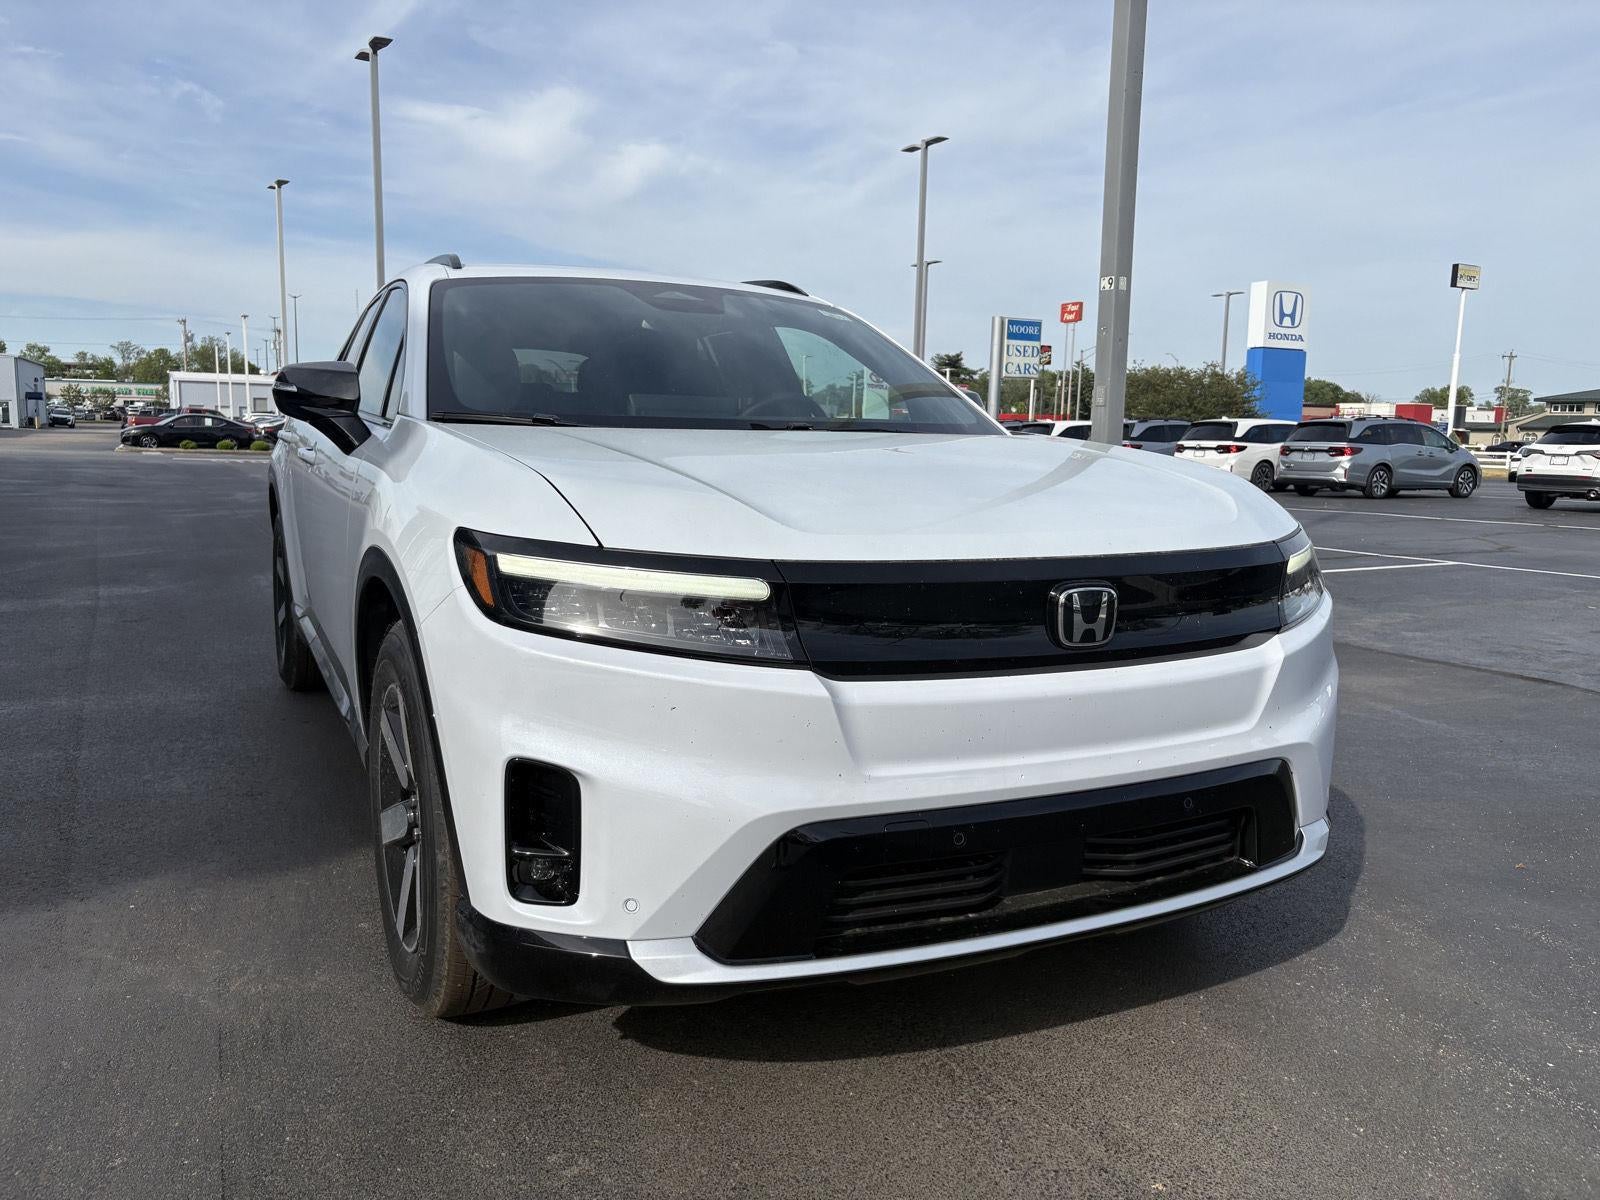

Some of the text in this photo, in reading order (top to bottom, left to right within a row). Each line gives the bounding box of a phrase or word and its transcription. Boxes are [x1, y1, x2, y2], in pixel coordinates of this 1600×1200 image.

[1008, 325, 1040, 335] MOORE
[1268, 332, 1305, 343] HONDA
[1006, 345, 1040, 357] USED
[1005, 362, 1039, 376] CARS
